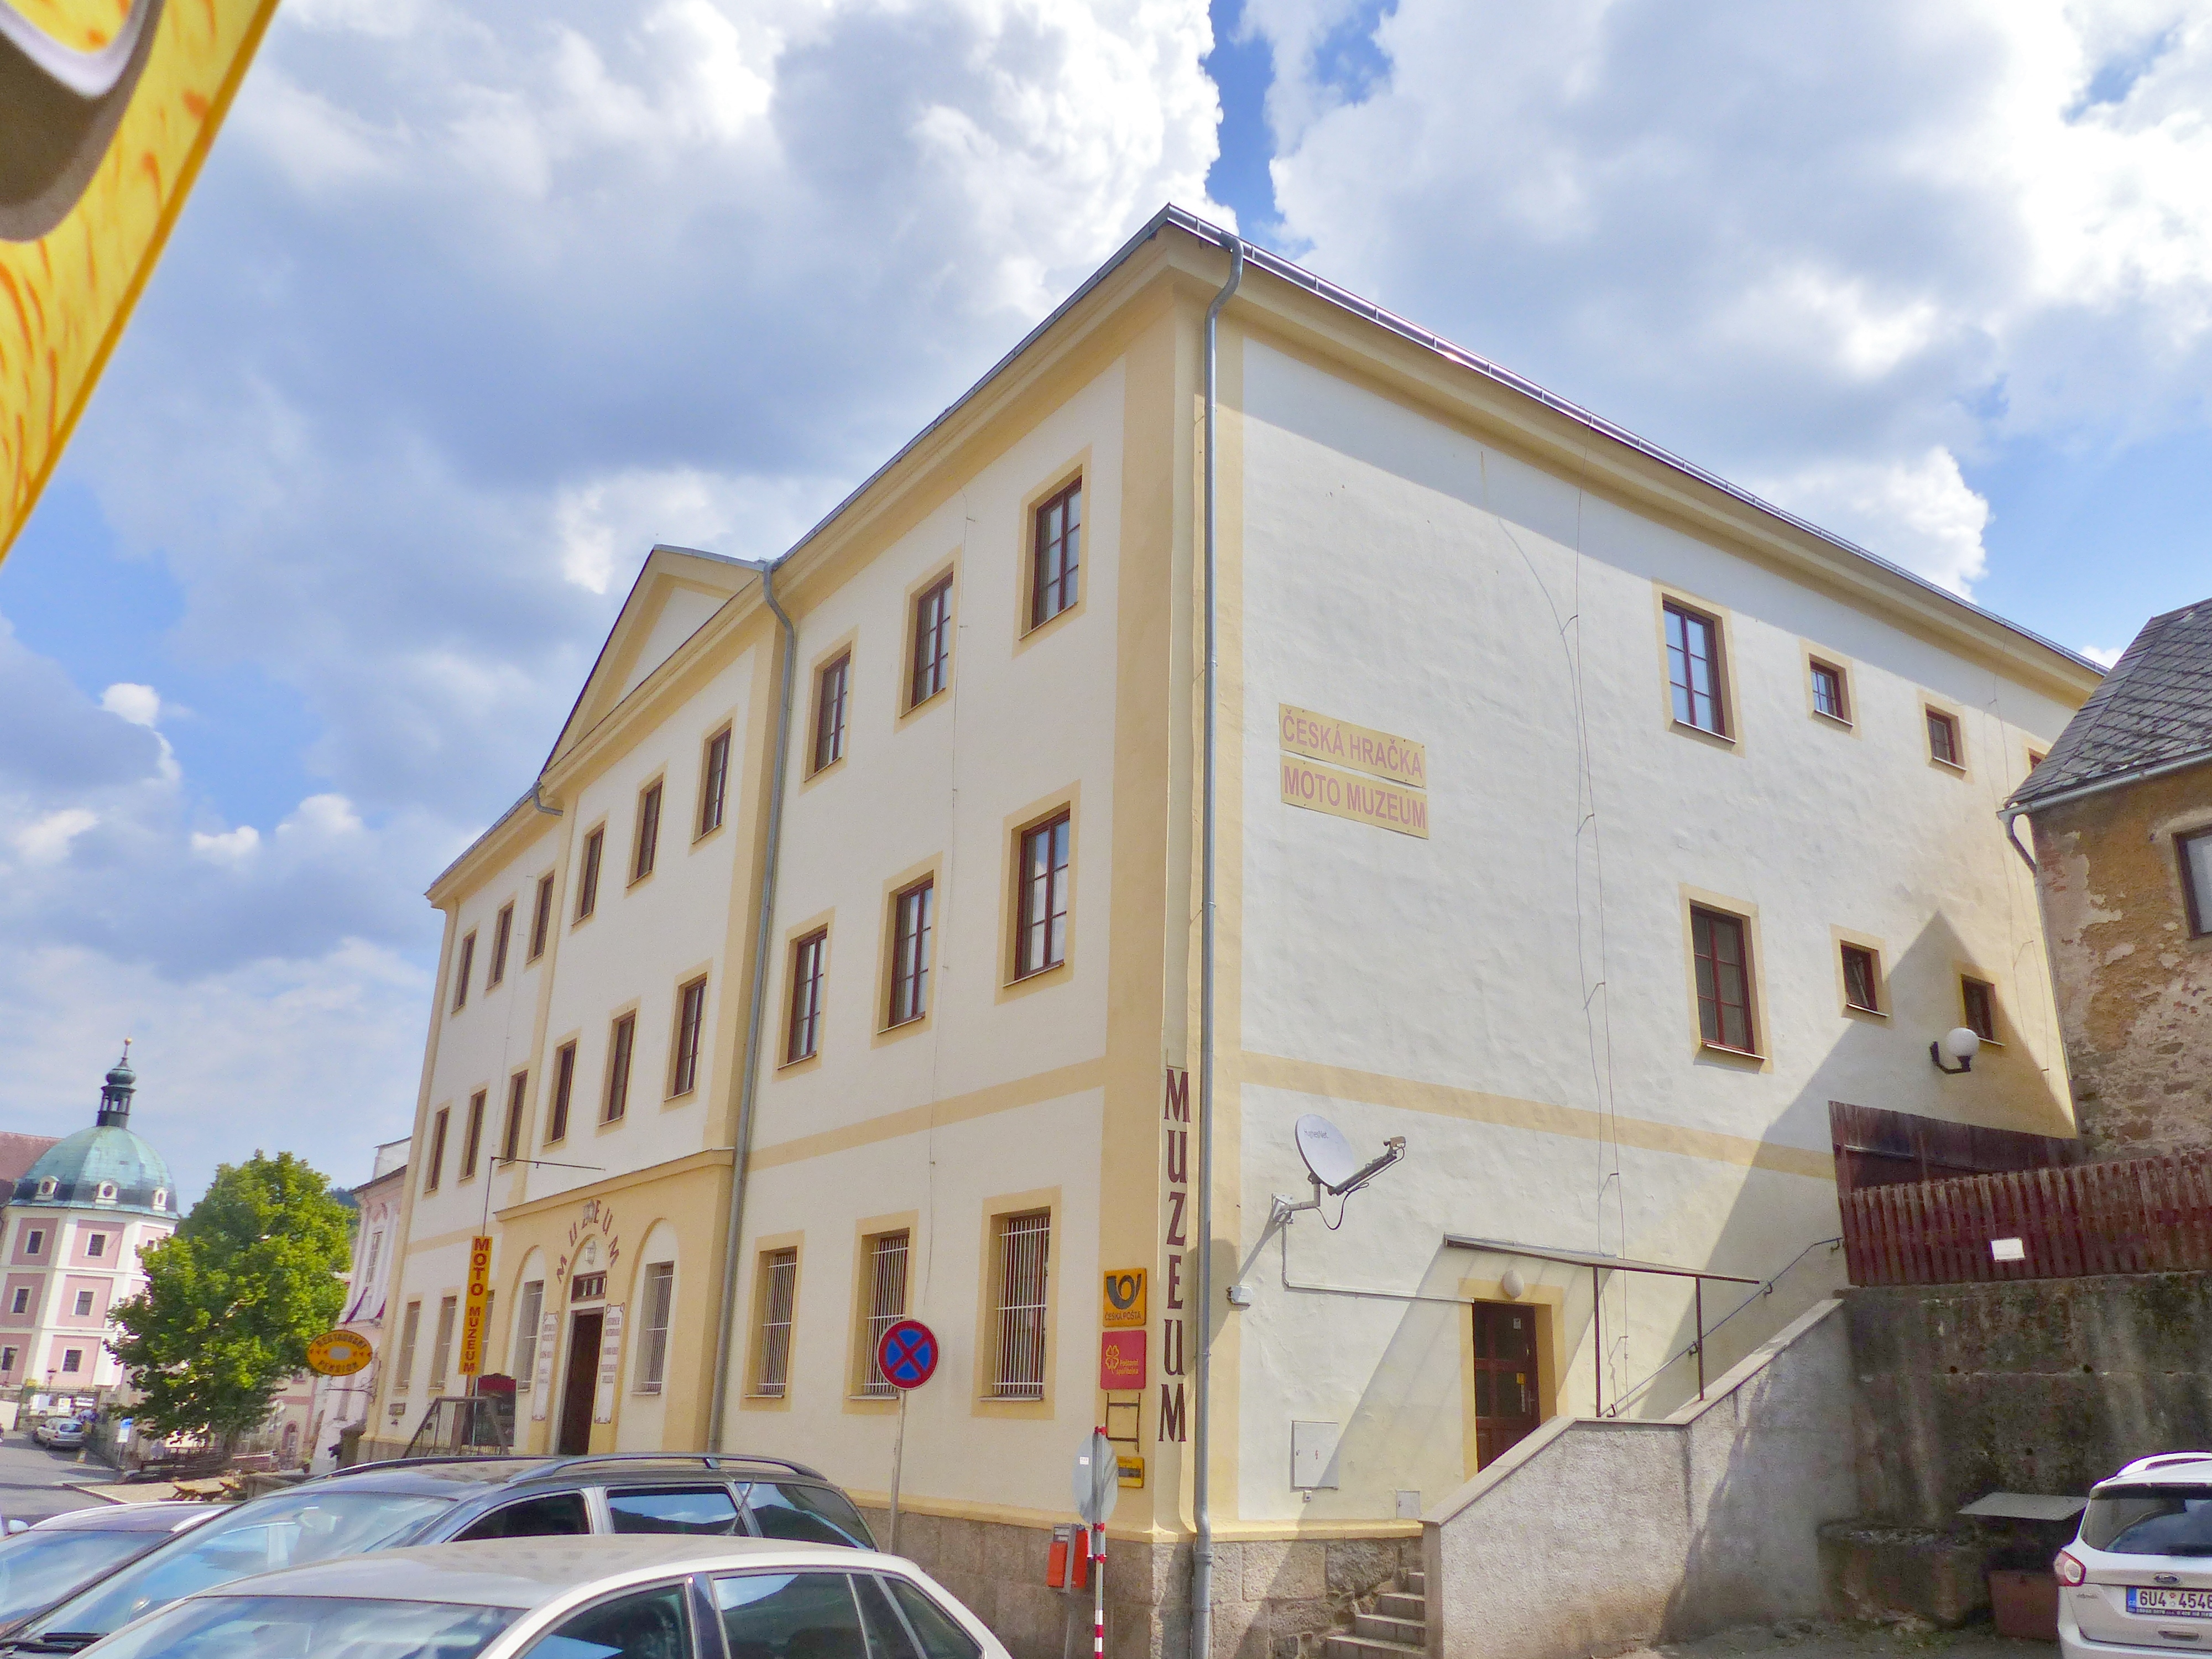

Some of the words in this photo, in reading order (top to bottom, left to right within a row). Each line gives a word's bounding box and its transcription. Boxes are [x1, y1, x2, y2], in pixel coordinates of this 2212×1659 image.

[1282, 708, 1345, 757] ČESKÁ
[1350, 733, 1423, 779] HRAČKA
[1284, 765, 1341, 807] MOTO
[1347, 782, 1427, 829] MUZEUM
[471, 1238, 489, 1296] MOTO
[1159, 1068, 1191, 1442] MUZEUM
[463, 1306, 481, 1373] MUZEUM
[1105, 1311, 1122, 1321] ČESKÁ
[1123, 1310, 1141, 1320] POŠTA
[2140, 1590, 2166, 1607] 6U4
